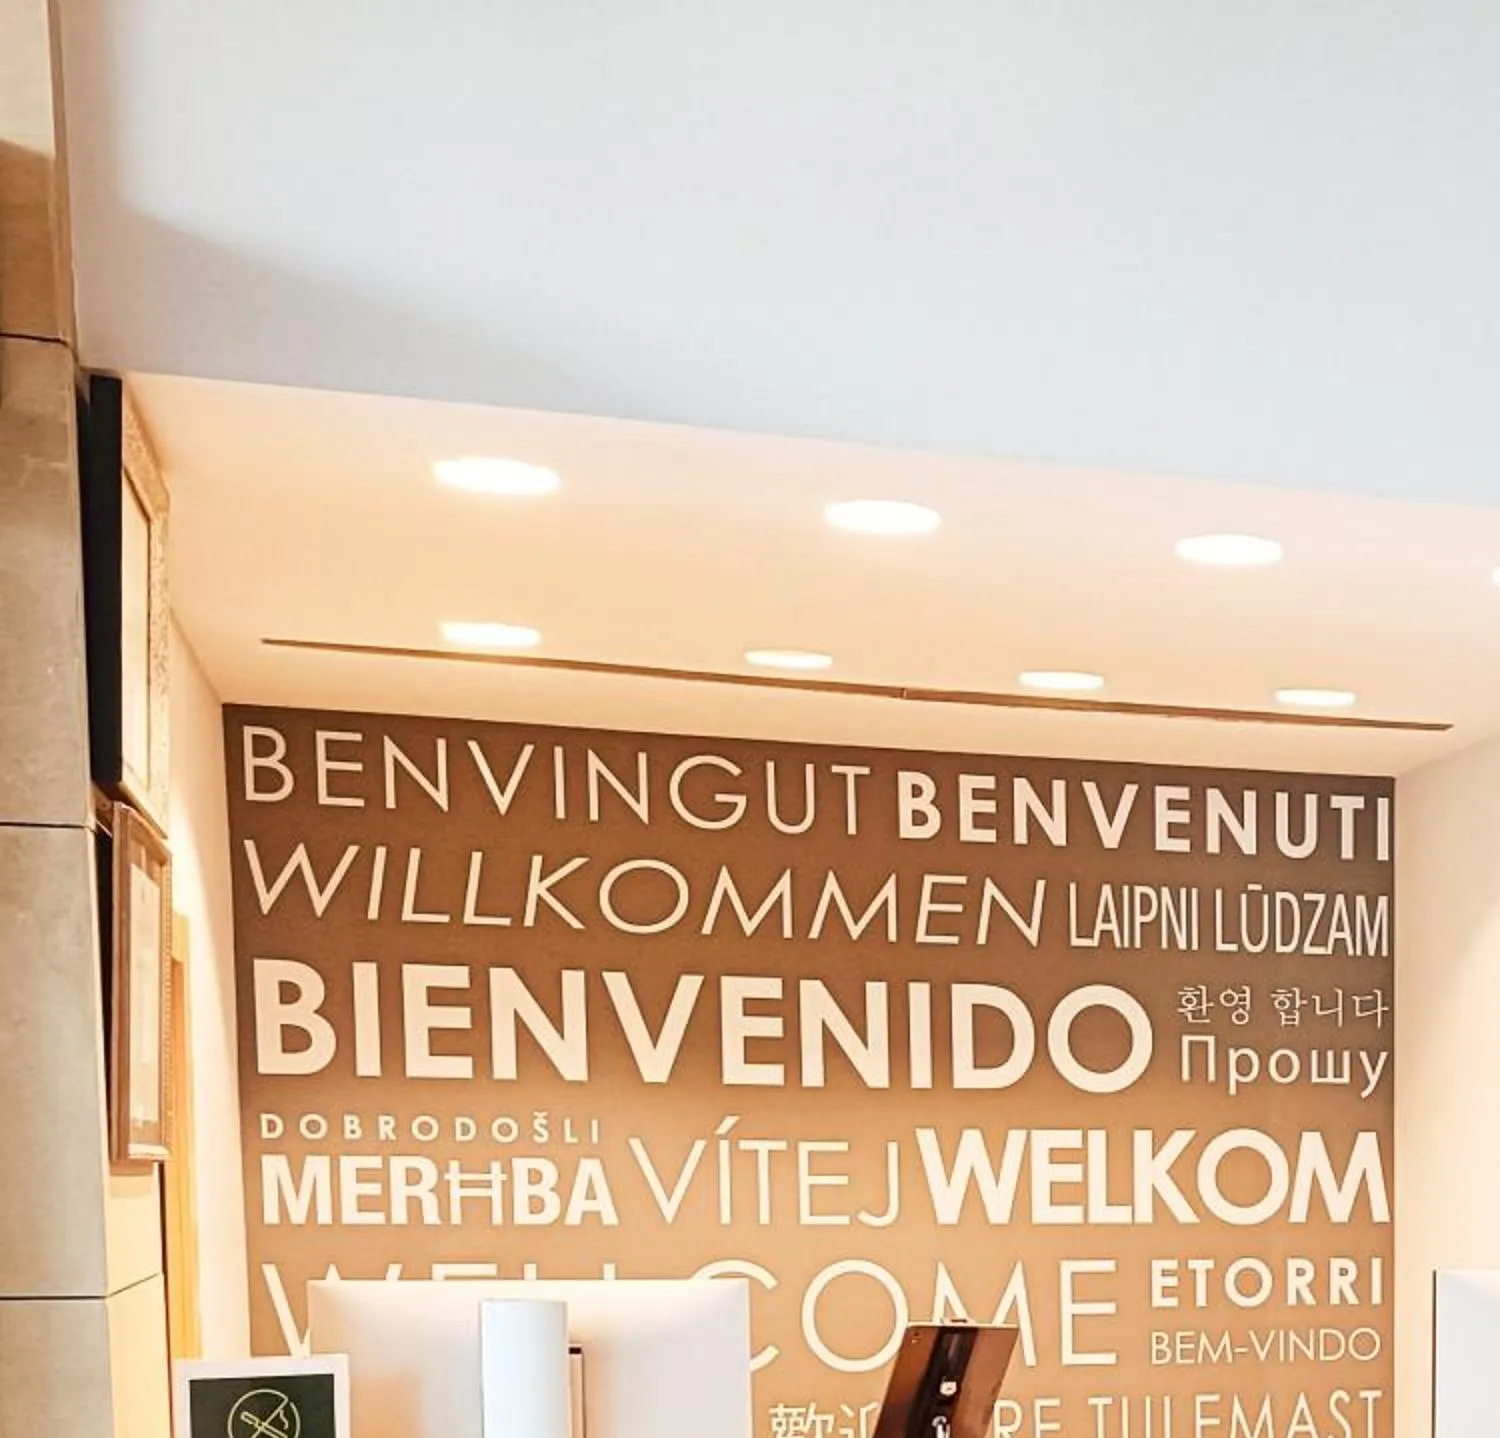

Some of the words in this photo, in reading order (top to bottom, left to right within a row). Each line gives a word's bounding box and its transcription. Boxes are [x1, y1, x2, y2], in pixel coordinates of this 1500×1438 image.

[242, 725, 871, 835] BENVINGUT
[897, 771, 1390, 862] BENVENUTI
[243, 839, 1047, 948] WILLKOMMEN
[1069, 882, 1200, 951] LAIPNI
[1215, 884, 1390, 957] LŪDZAM
[252, 957, 1153, 1093] BIENVENIDO
[1177, 985, 1251, 1026] 환영
[1270, 987, 1390, 1029] 합니다
[1181, 1034, 1389, 1099] Прошу
[260, 1112, 600, 1144] DOBRODOŠLI
[628, 1115, 900, 1228] VÍTEJ
[915, 1127, 1391, 1225] WELKOM
[1150, 1256, 1383, 1308] ETORRI
[1150, 1327, 1382, 1366] BEM-VINDO
